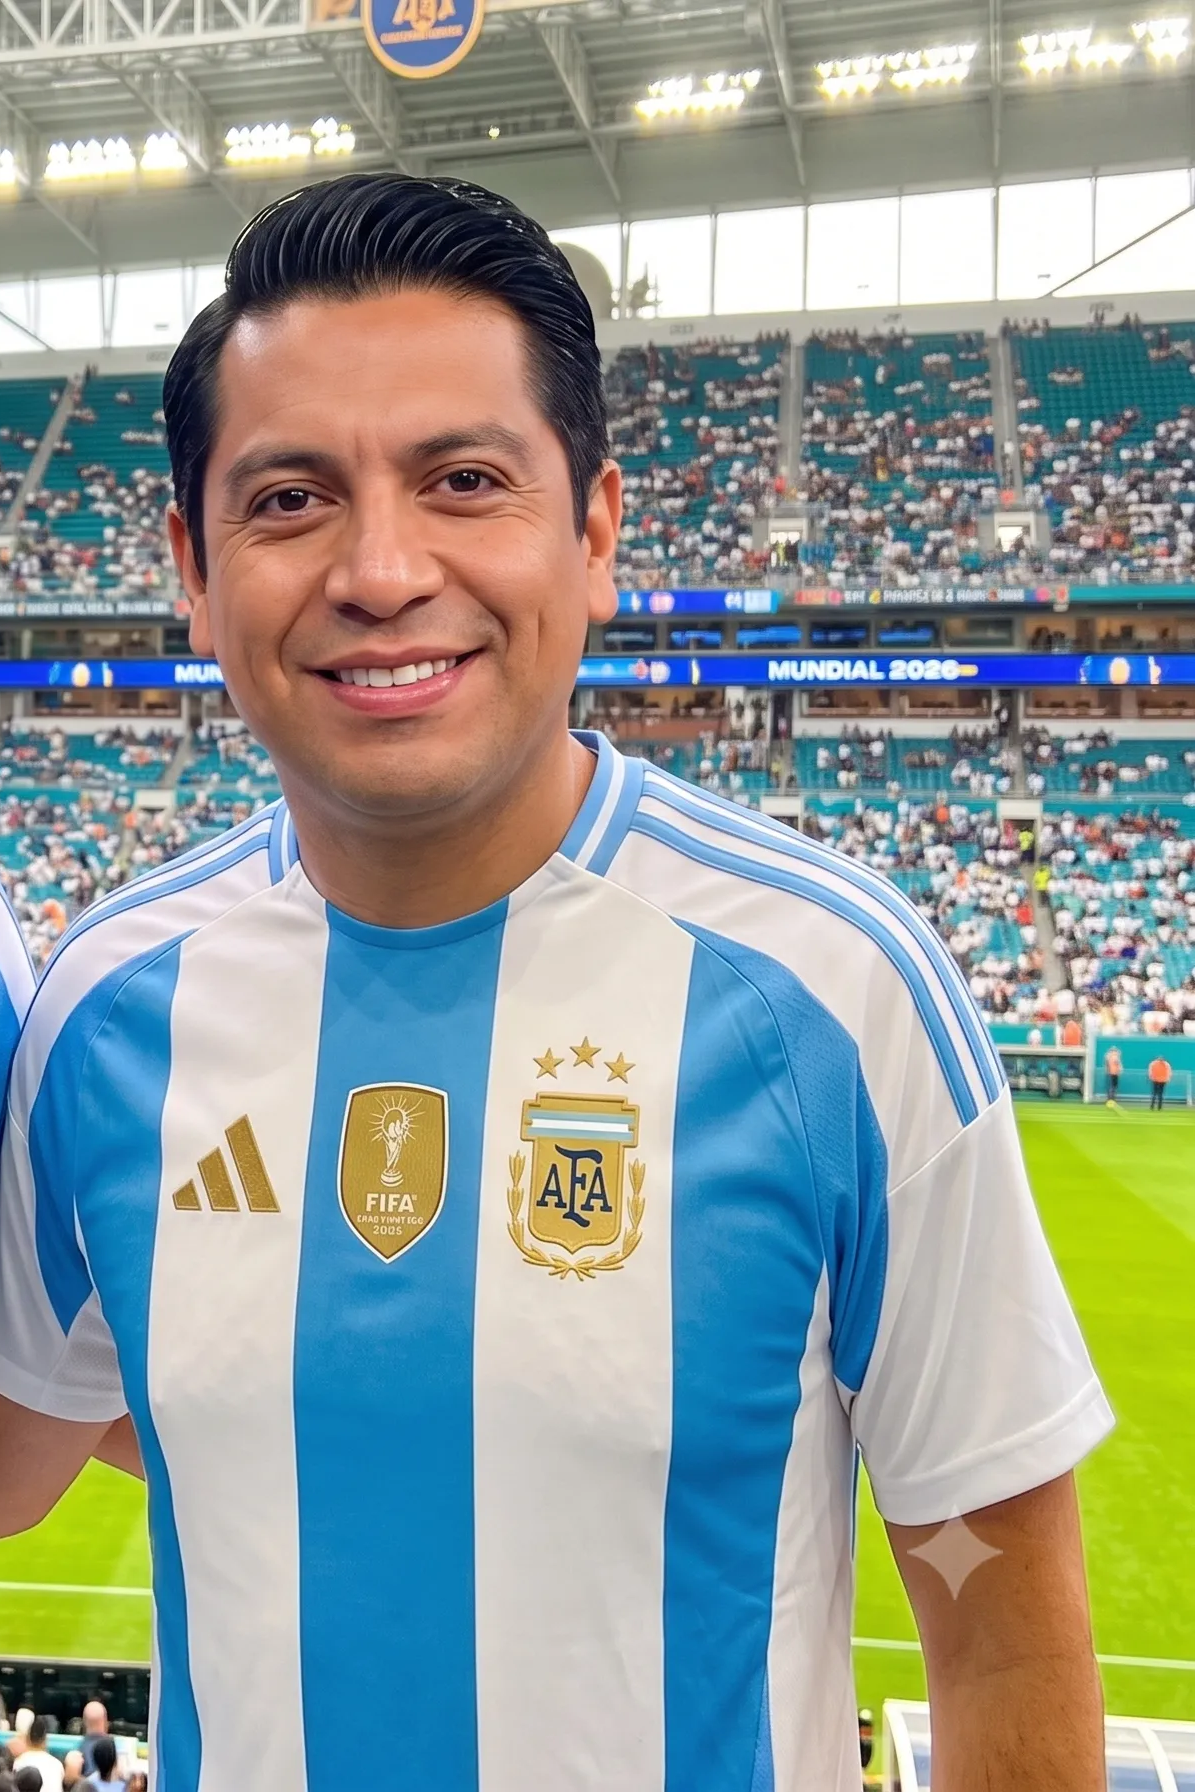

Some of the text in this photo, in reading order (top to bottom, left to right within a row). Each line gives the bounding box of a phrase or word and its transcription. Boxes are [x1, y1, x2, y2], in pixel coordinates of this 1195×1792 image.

[175, 664, 225, 683] MUN
[768, 659, 960, 681] MUNDIAL 2026
[536, 1144, 612, 1228] AFA
[366, 1193, 415, 1213] FIFA
